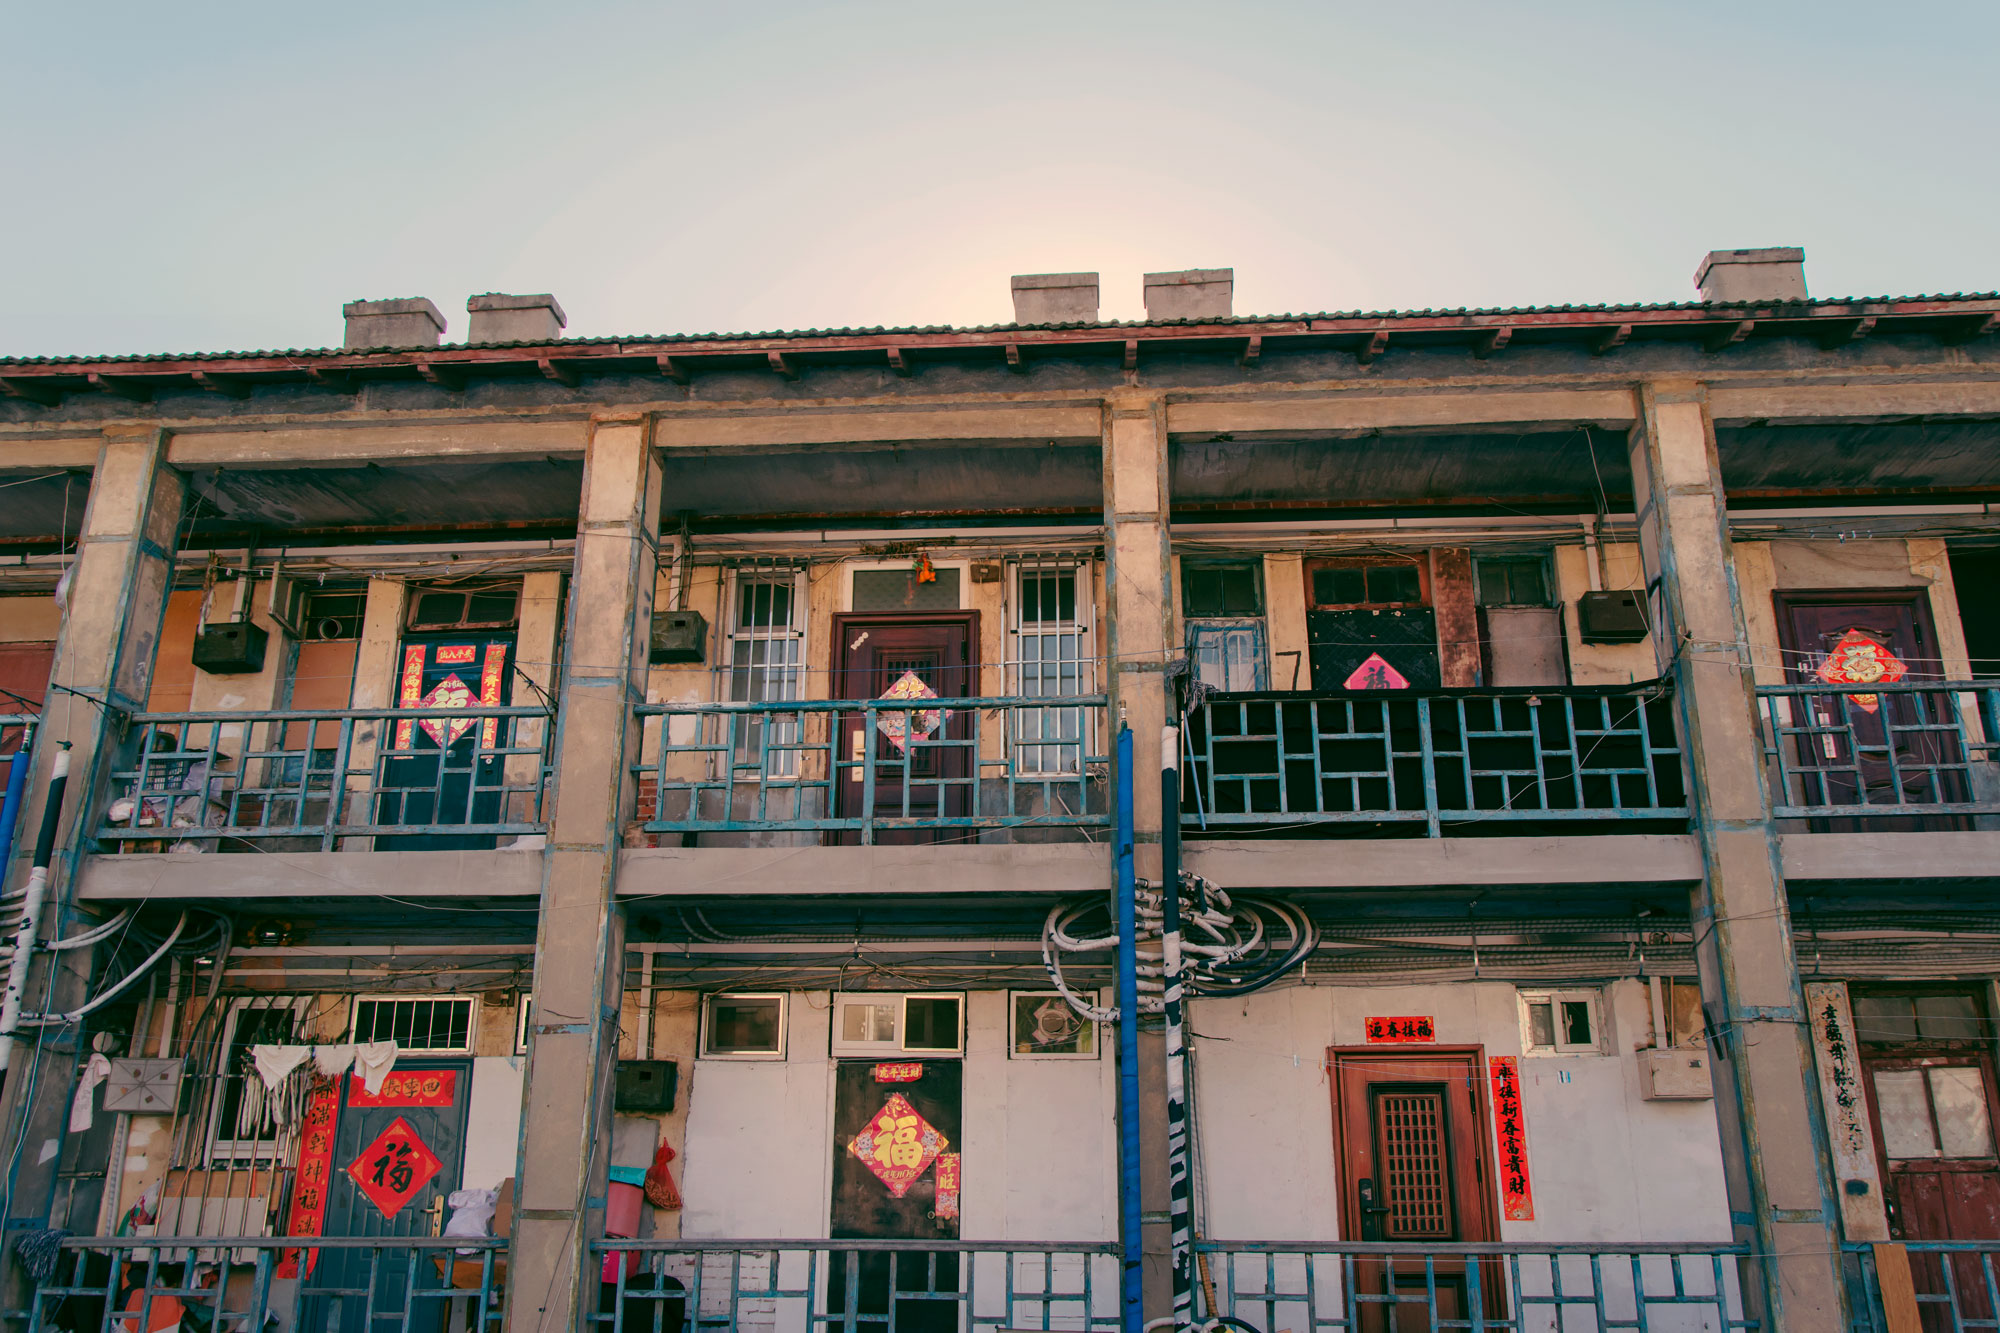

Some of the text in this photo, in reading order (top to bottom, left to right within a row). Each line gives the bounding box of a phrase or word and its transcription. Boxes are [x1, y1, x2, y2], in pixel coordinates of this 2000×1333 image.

[440, 649, 473, 660] 出入平安
[1369, 1020, 1432, 1038] 迎春接福
[873, 1115, 924, 1169] 福
[373, 1141, 413, 1194] 福
